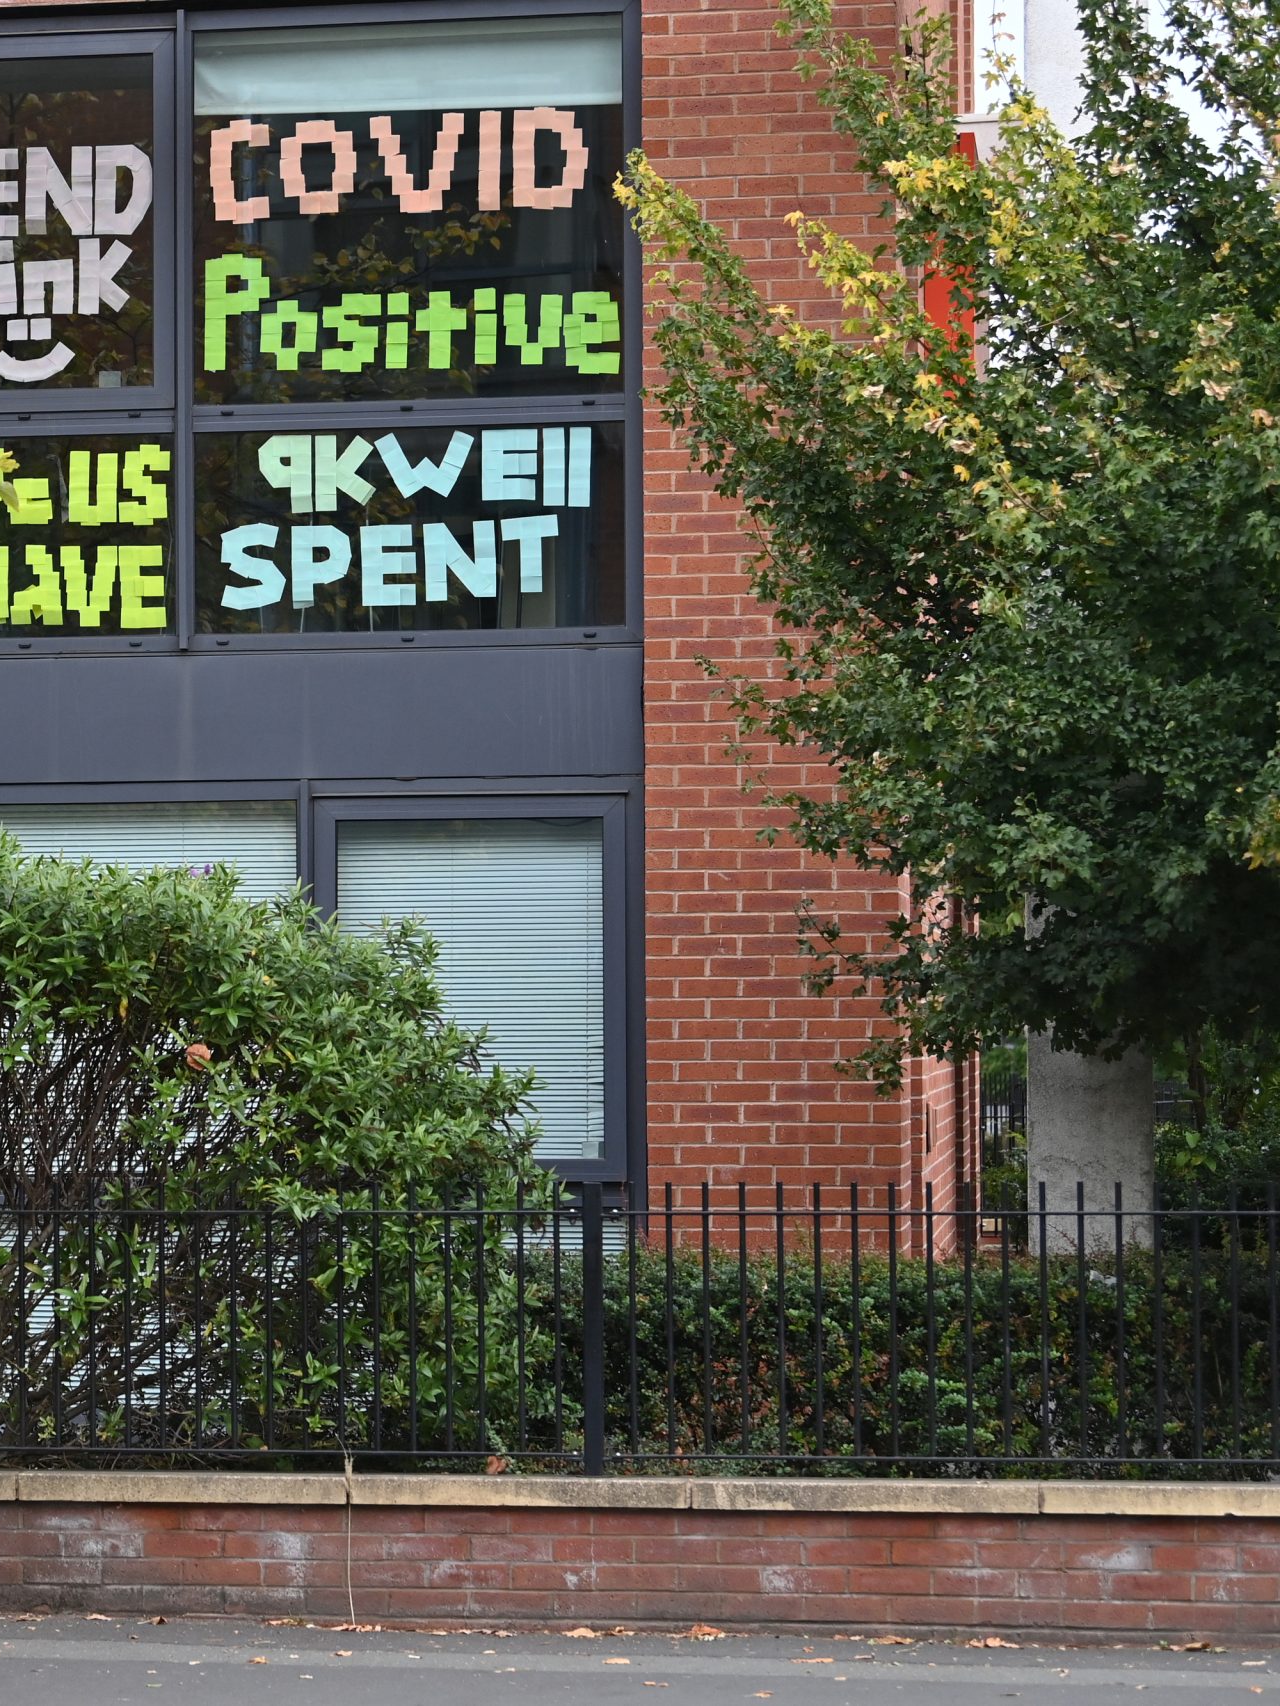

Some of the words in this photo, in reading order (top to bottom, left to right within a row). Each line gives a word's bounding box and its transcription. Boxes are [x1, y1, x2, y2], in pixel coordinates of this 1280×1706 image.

[210, 107, 588, 224] COVID
[204, 254, 620, 374] Positive
[68, 444, 170, 526] US
[220, 514, 559, 611] SPENT
